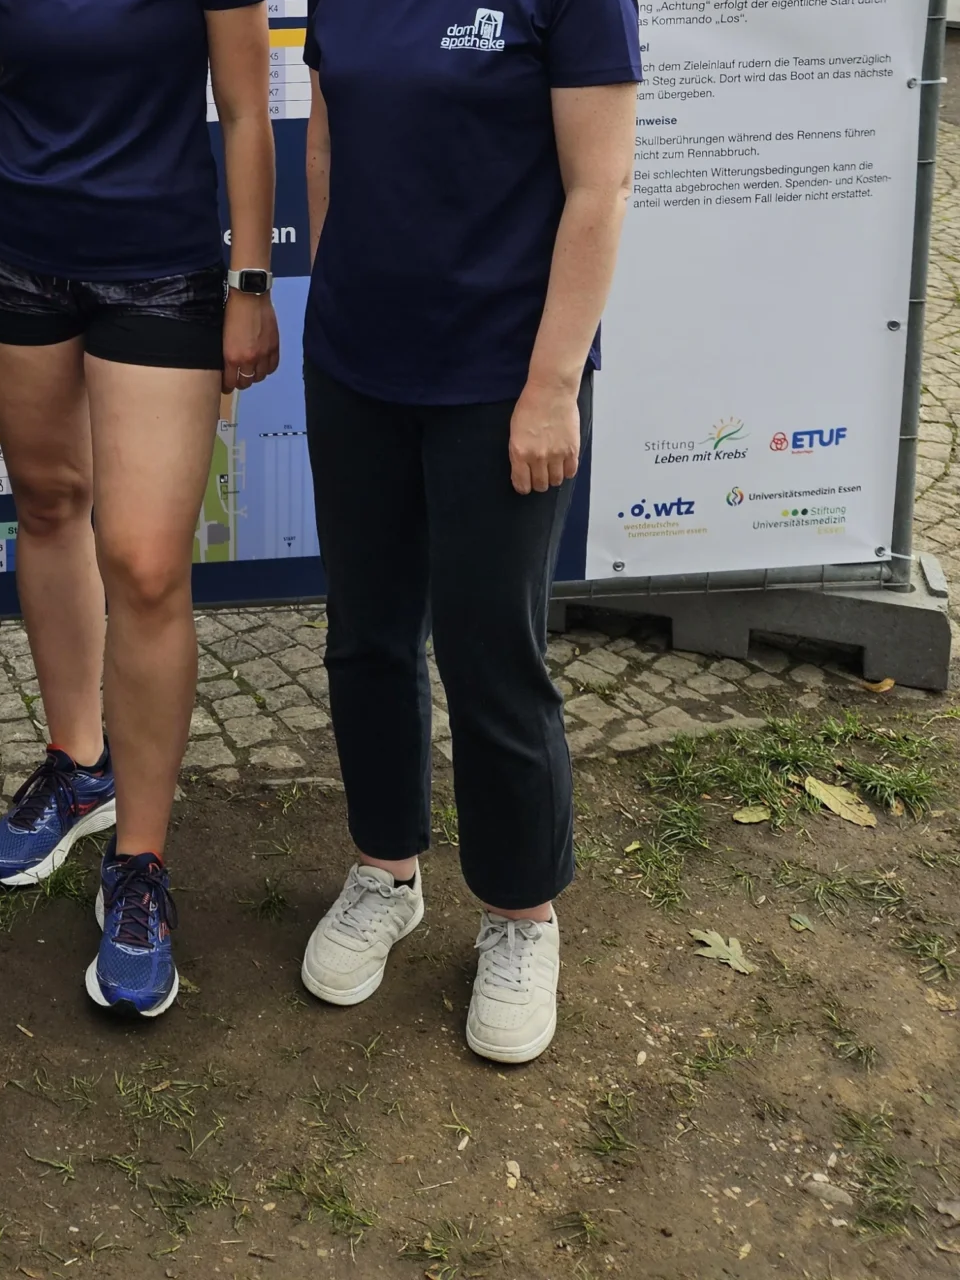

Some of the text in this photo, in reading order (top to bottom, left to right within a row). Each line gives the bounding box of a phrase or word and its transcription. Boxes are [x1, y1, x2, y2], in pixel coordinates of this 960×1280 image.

[447, 24, 476, 36] dom
[441, 35, 505, 50] apotheke
[635, 115, 677, 126] inweise
[791, 427, 848, 449] ETUF
[644, 440, 695, 452] Stiftung
[654, 453, 689, 464] Leben
[692, 451, 711, 462] mit
[749, 484, 862, 501] Universitätsmedizin Essen
[810, 506, 847, 516] Stiftung
[752, 516, 846, 530] Universitätsmedizin
